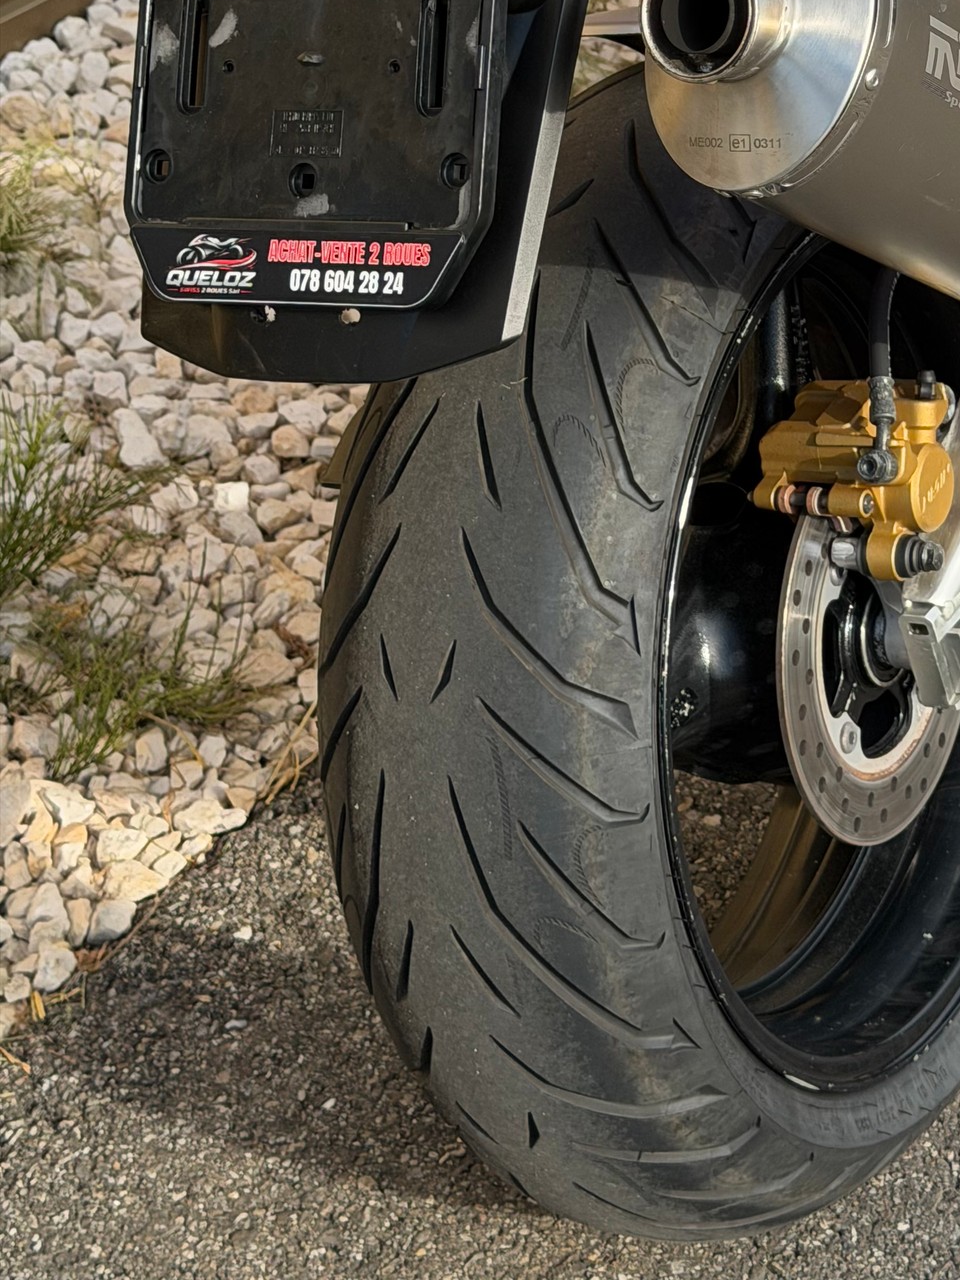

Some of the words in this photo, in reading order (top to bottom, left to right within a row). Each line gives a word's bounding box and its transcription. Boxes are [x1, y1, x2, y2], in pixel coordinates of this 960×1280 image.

[689, 136, 723, 148] ME002
[753, 138, 782, 149] 0311
[267, 239, 366, 265] ACHAT-VENTE
[368, 242, 381, 266] 2
[383, 241, 432, 267] ROUES
[165, 269, 257, 288] QUELOZ
[289, 268, 321, 292] 078
[323, 269, 355, 294] 604
[357, 270, 380, 294] 28
[382, 271, 404, 295] 24
